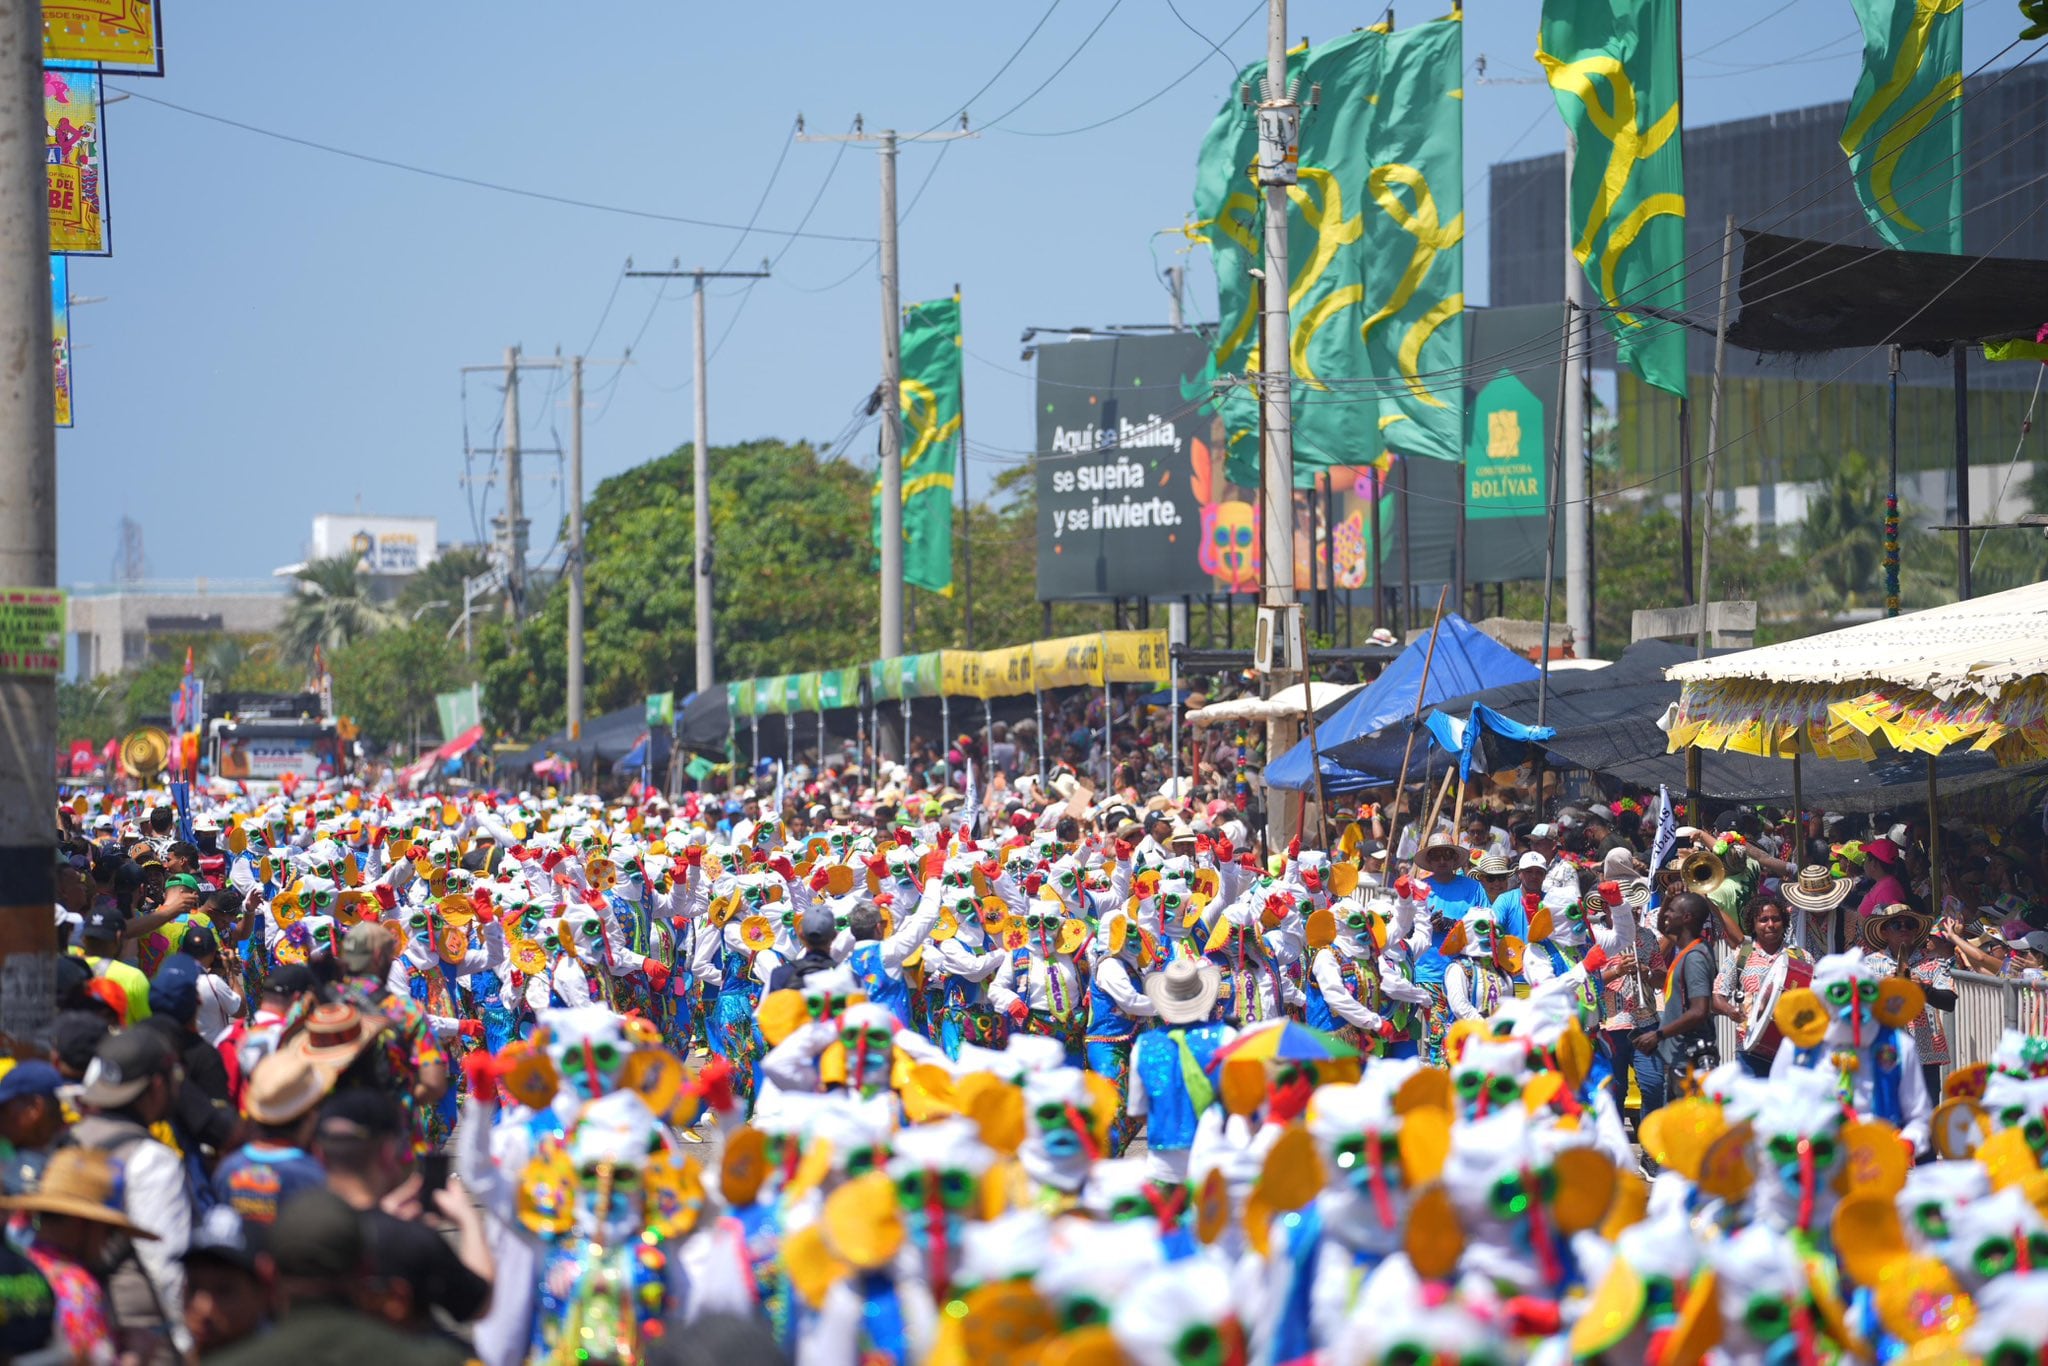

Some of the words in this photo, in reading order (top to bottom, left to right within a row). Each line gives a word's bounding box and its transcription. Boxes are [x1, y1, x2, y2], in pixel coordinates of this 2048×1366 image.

[56, 179, 75, 190] DEL
[1052, 423, 1094, 455] Aquí
[1094, 429, 1118, 449] se
[1120, 414, 1182, 453] baila,
[1053, 470, 1075, 493] se
[1077, 456, 1145, 491] sueña
[1472, 476, 1539, 498] BOLÍVAR
[1053, 509, 1066, 538] y
[1068, 508, 1090, 531] se
[1092, 495, 1182, 530] invierte.
